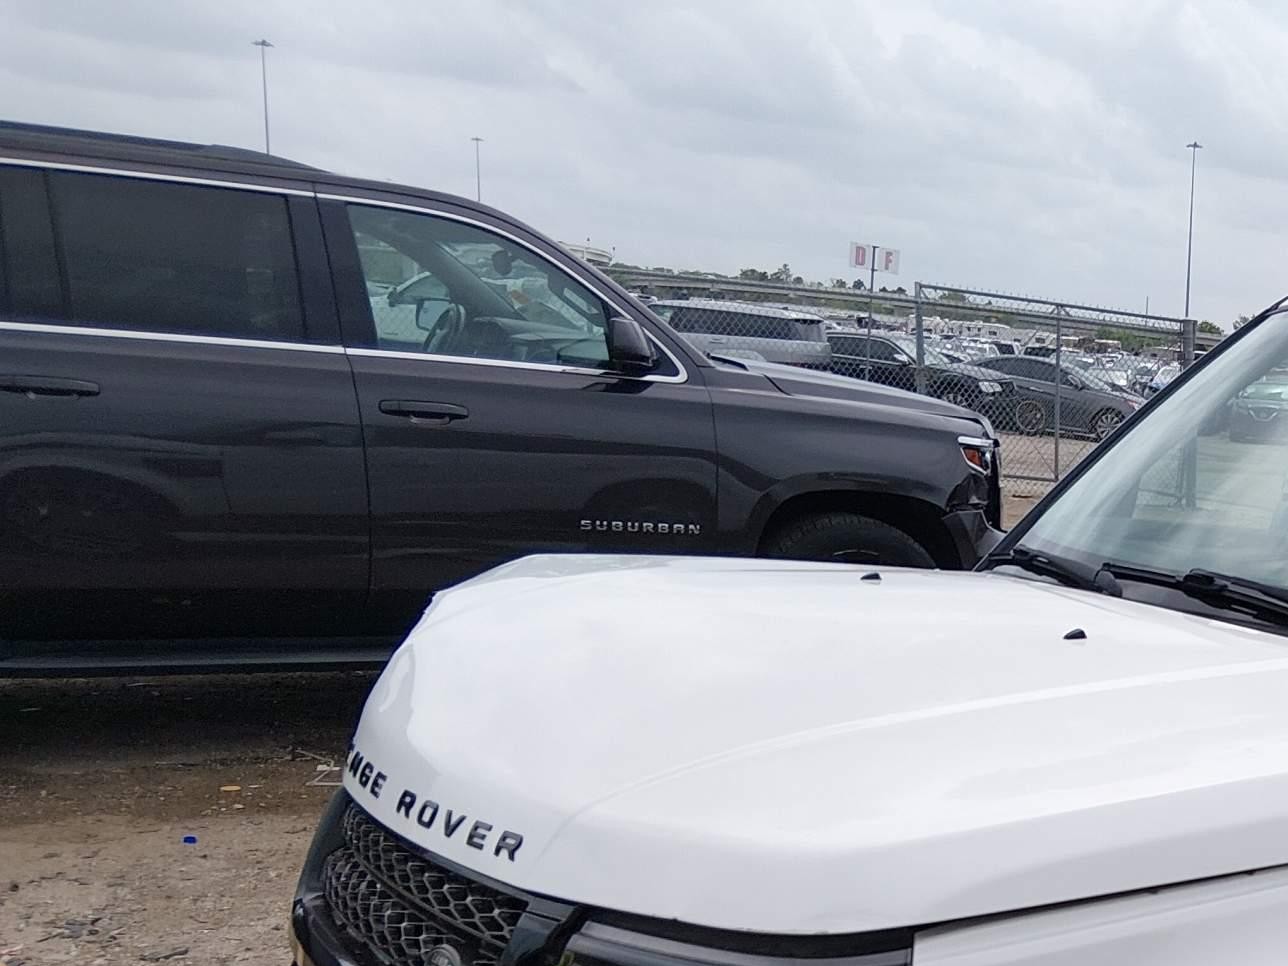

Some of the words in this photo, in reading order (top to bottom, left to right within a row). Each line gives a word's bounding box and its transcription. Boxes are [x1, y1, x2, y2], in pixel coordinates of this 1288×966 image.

[855, 245, 866, 266] D
[885, 251, 893, 270] F
[580, 519, 700, 535] SUBURBAN
[348, 750, 388, 799] NGE
[395, 789, 524, 862] ROVER
